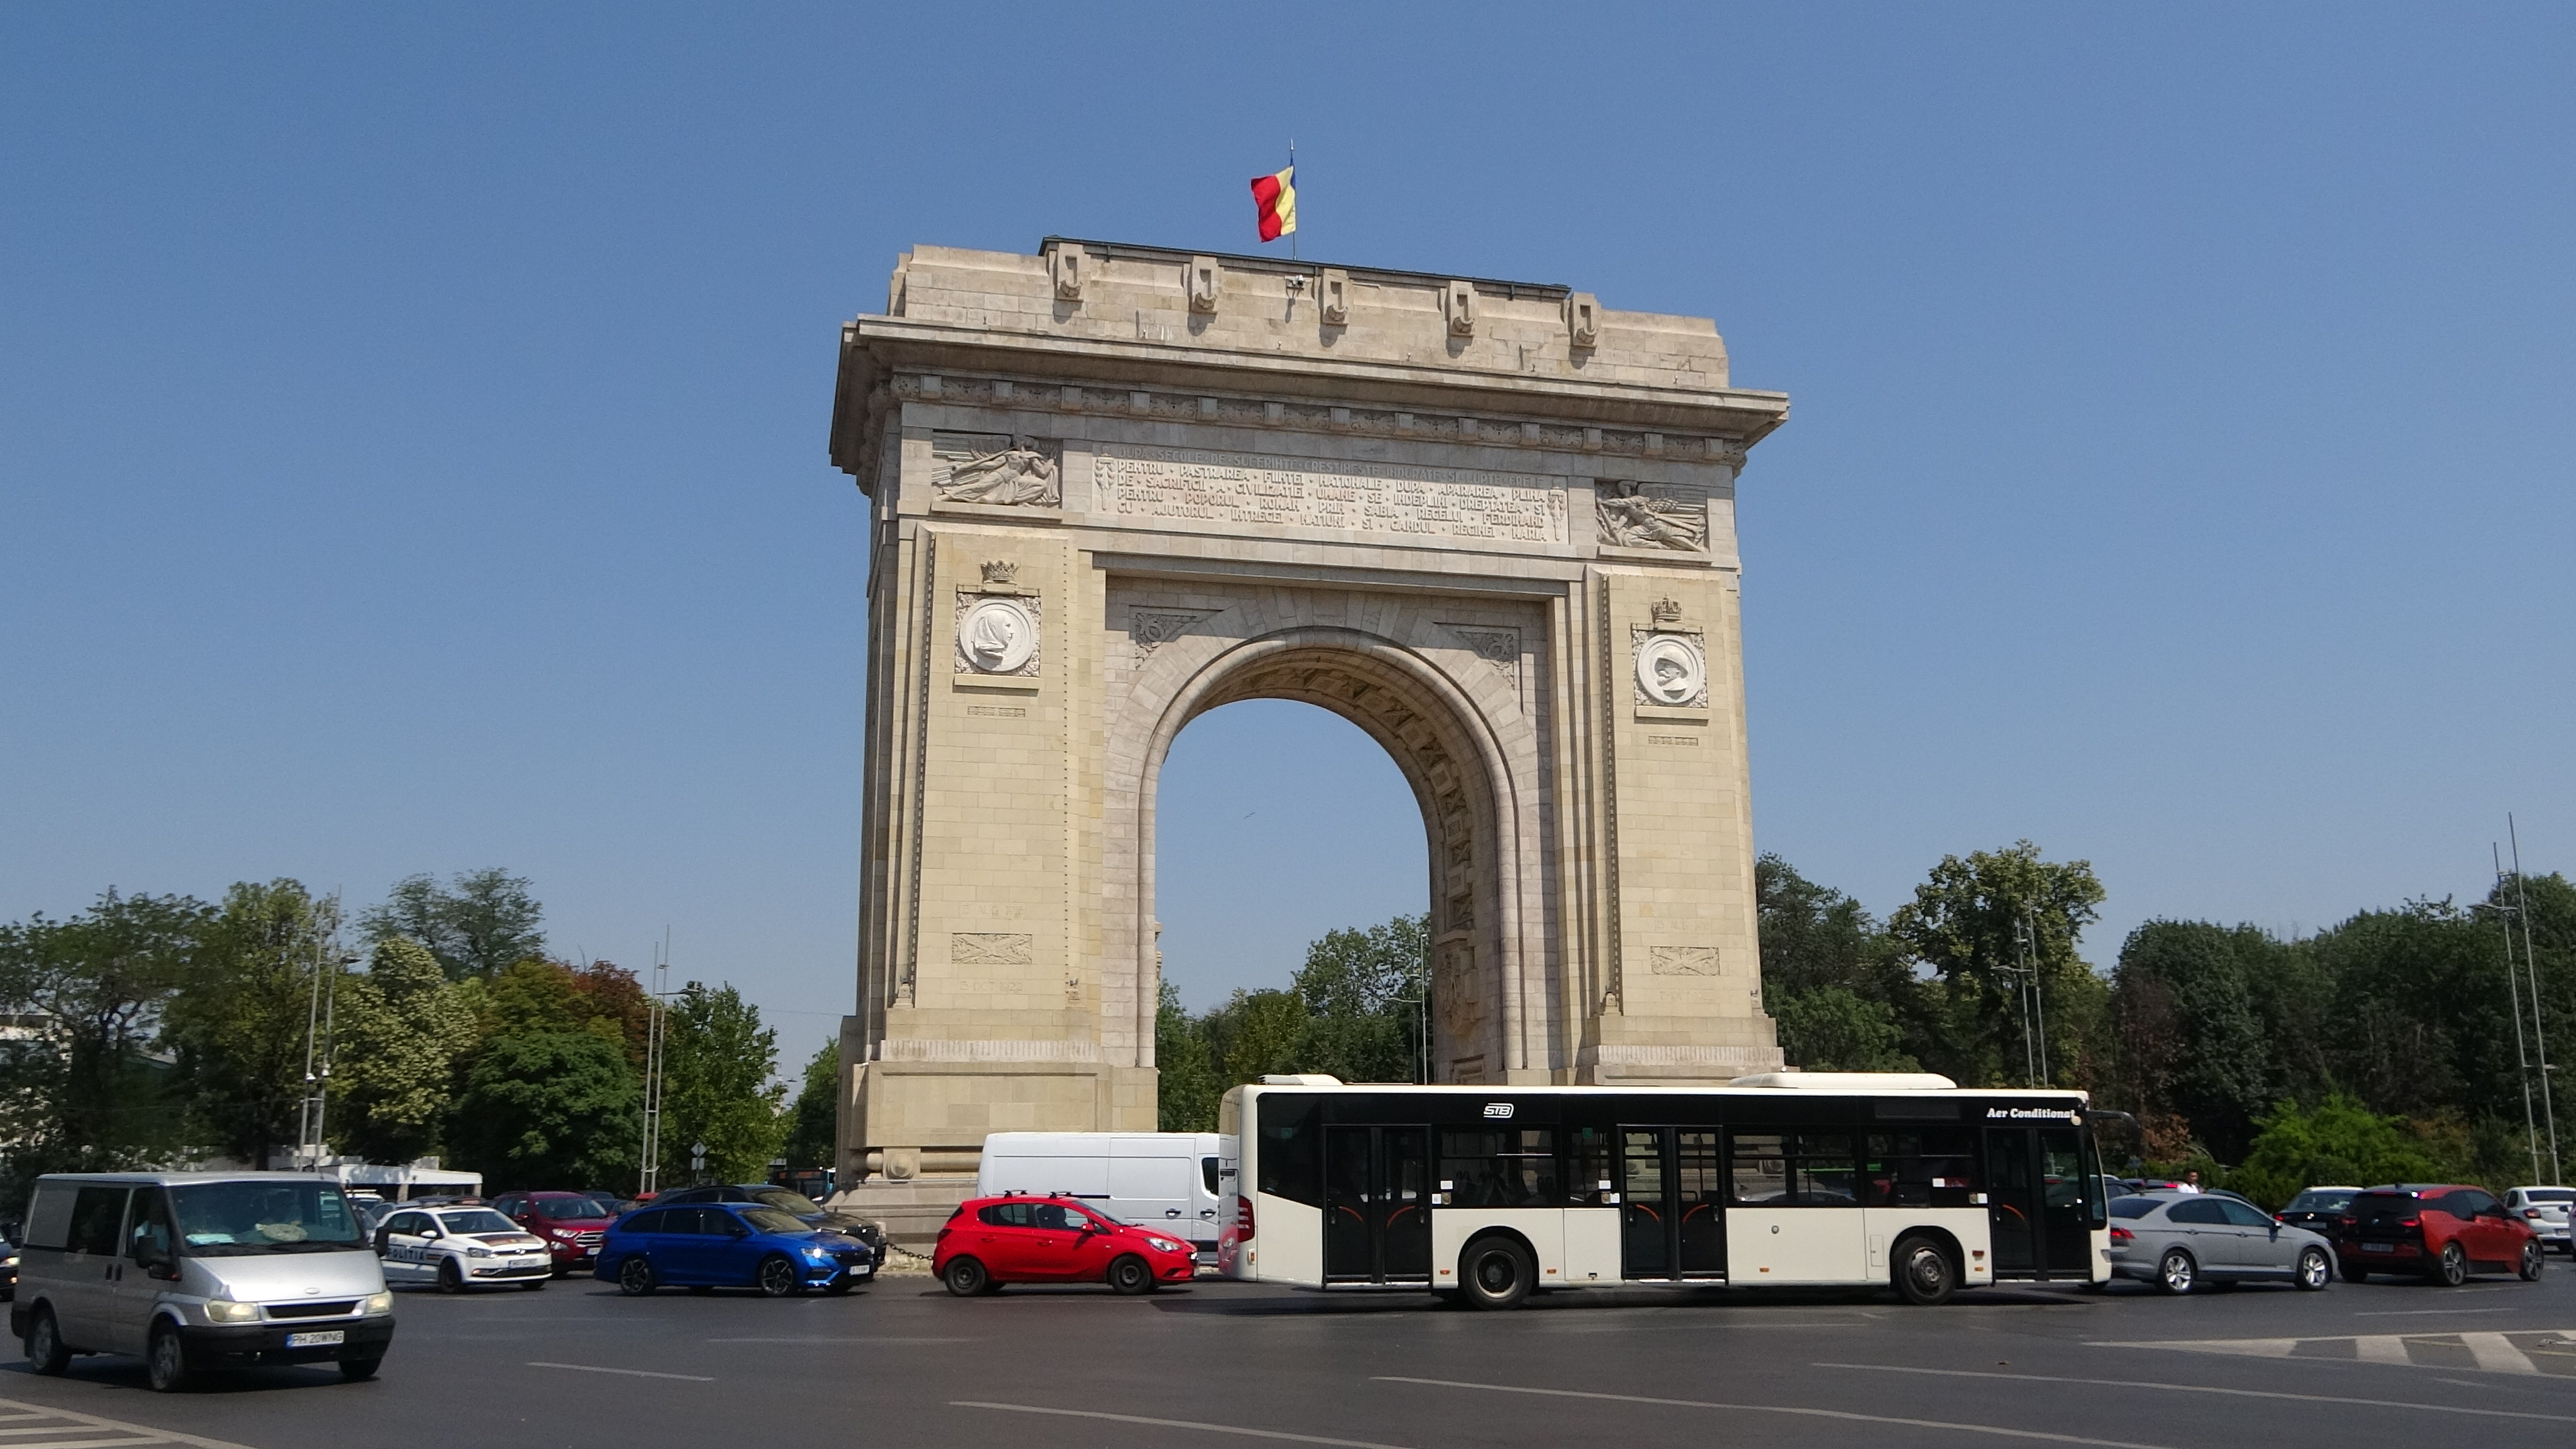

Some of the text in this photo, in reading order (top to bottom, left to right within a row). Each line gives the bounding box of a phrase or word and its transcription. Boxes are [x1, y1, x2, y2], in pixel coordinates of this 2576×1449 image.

[1118, 446, 1148, 460] DUPA
[1157, 449, 1204, 462] SECOLE
[1211, 453, 1226, 465] DE
[1118, 460, 1545, 502] PENTRU PASTRAREA FIINTEI NATIONALE DUPA APARAREA PLINA
[1118, 475, 1545, 516] DE SACRIFICII A CIVILIZATIEI UMANE SE INDEPLINI DREPTATEA SI
[1118, 488, 1544, 528] PENTRU POPORUL ROMAN PRIN SABIA REGELUI FERDINAND
[1118, 502, 1546, 542] CU AJUTORUL INTREGEI NATIUNI SI GANDUL REGINEI MARIA
[1483, 1105, 1511, 1116] STB
[1986, 1108, 2076, 1119] Aer Conditionat
[293, 1334, 307, 1344] PH
